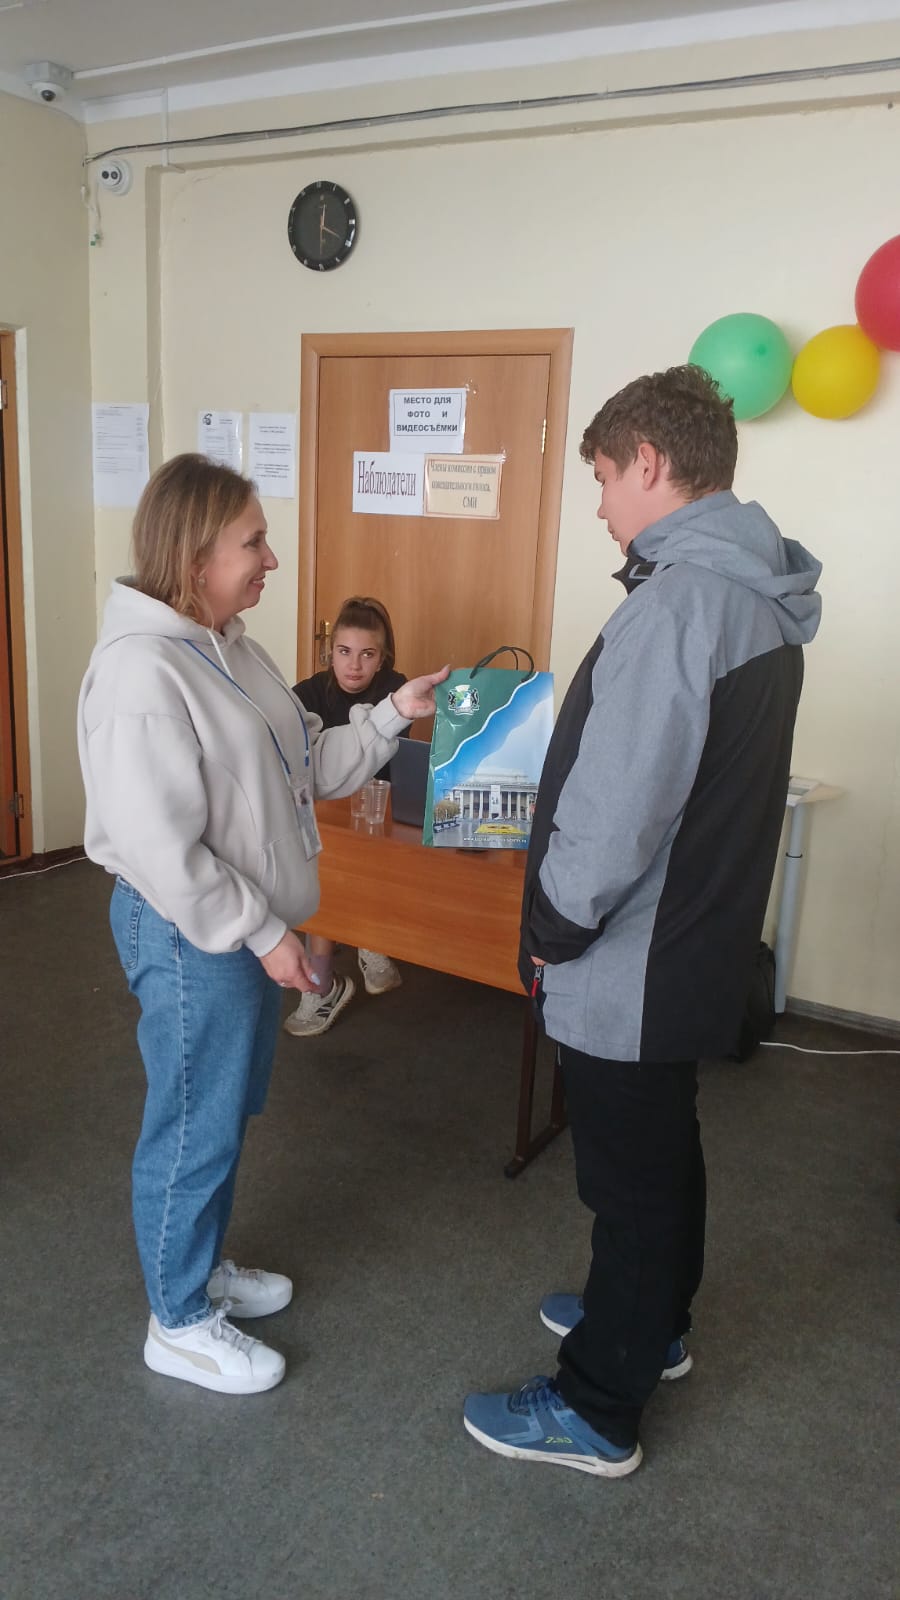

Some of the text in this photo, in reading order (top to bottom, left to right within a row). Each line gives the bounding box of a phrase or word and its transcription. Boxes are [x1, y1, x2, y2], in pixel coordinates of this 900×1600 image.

[434, 397, 451, 405] ДЛЯ
[396, 423, 458, 432] ВИДЕОСЪЁМКИ
[357, 460, 416, 499] Наблюдатели
[462, 496, 478, 509] СМИ
